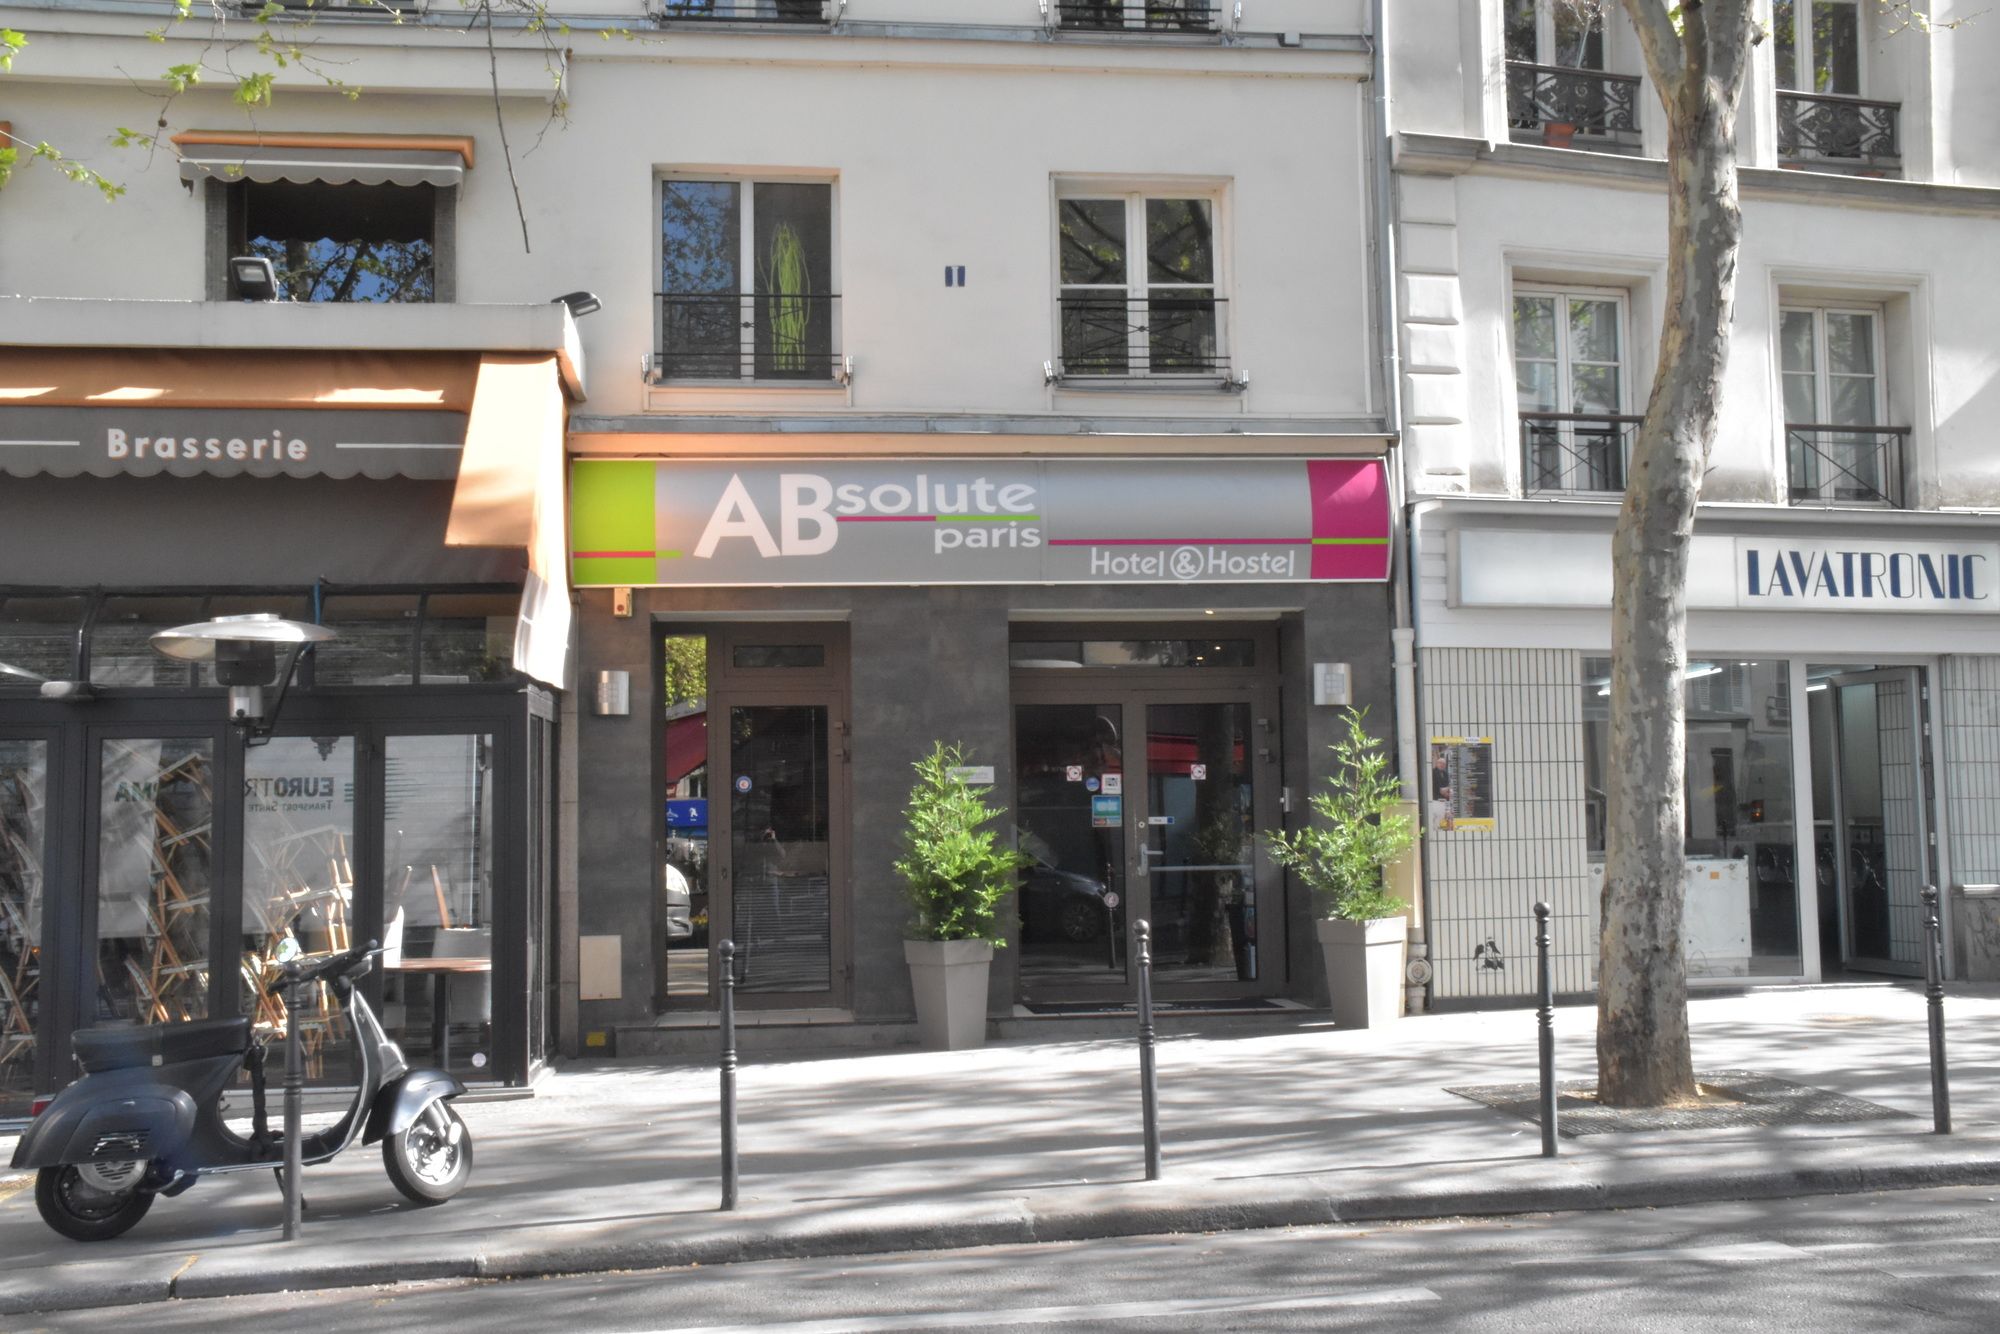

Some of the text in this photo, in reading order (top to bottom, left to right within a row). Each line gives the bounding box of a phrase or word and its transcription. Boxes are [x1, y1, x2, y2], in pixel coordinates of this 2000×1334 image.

[107, 428, 308, 460] Brasserie
[934, 521, 1041, 554] paris
[1090, 546, 1164, 577] Hotel
[1208, 546, 1295, 577] Hostel
[1747, 549, 1988, 600] LAVATRONIC
